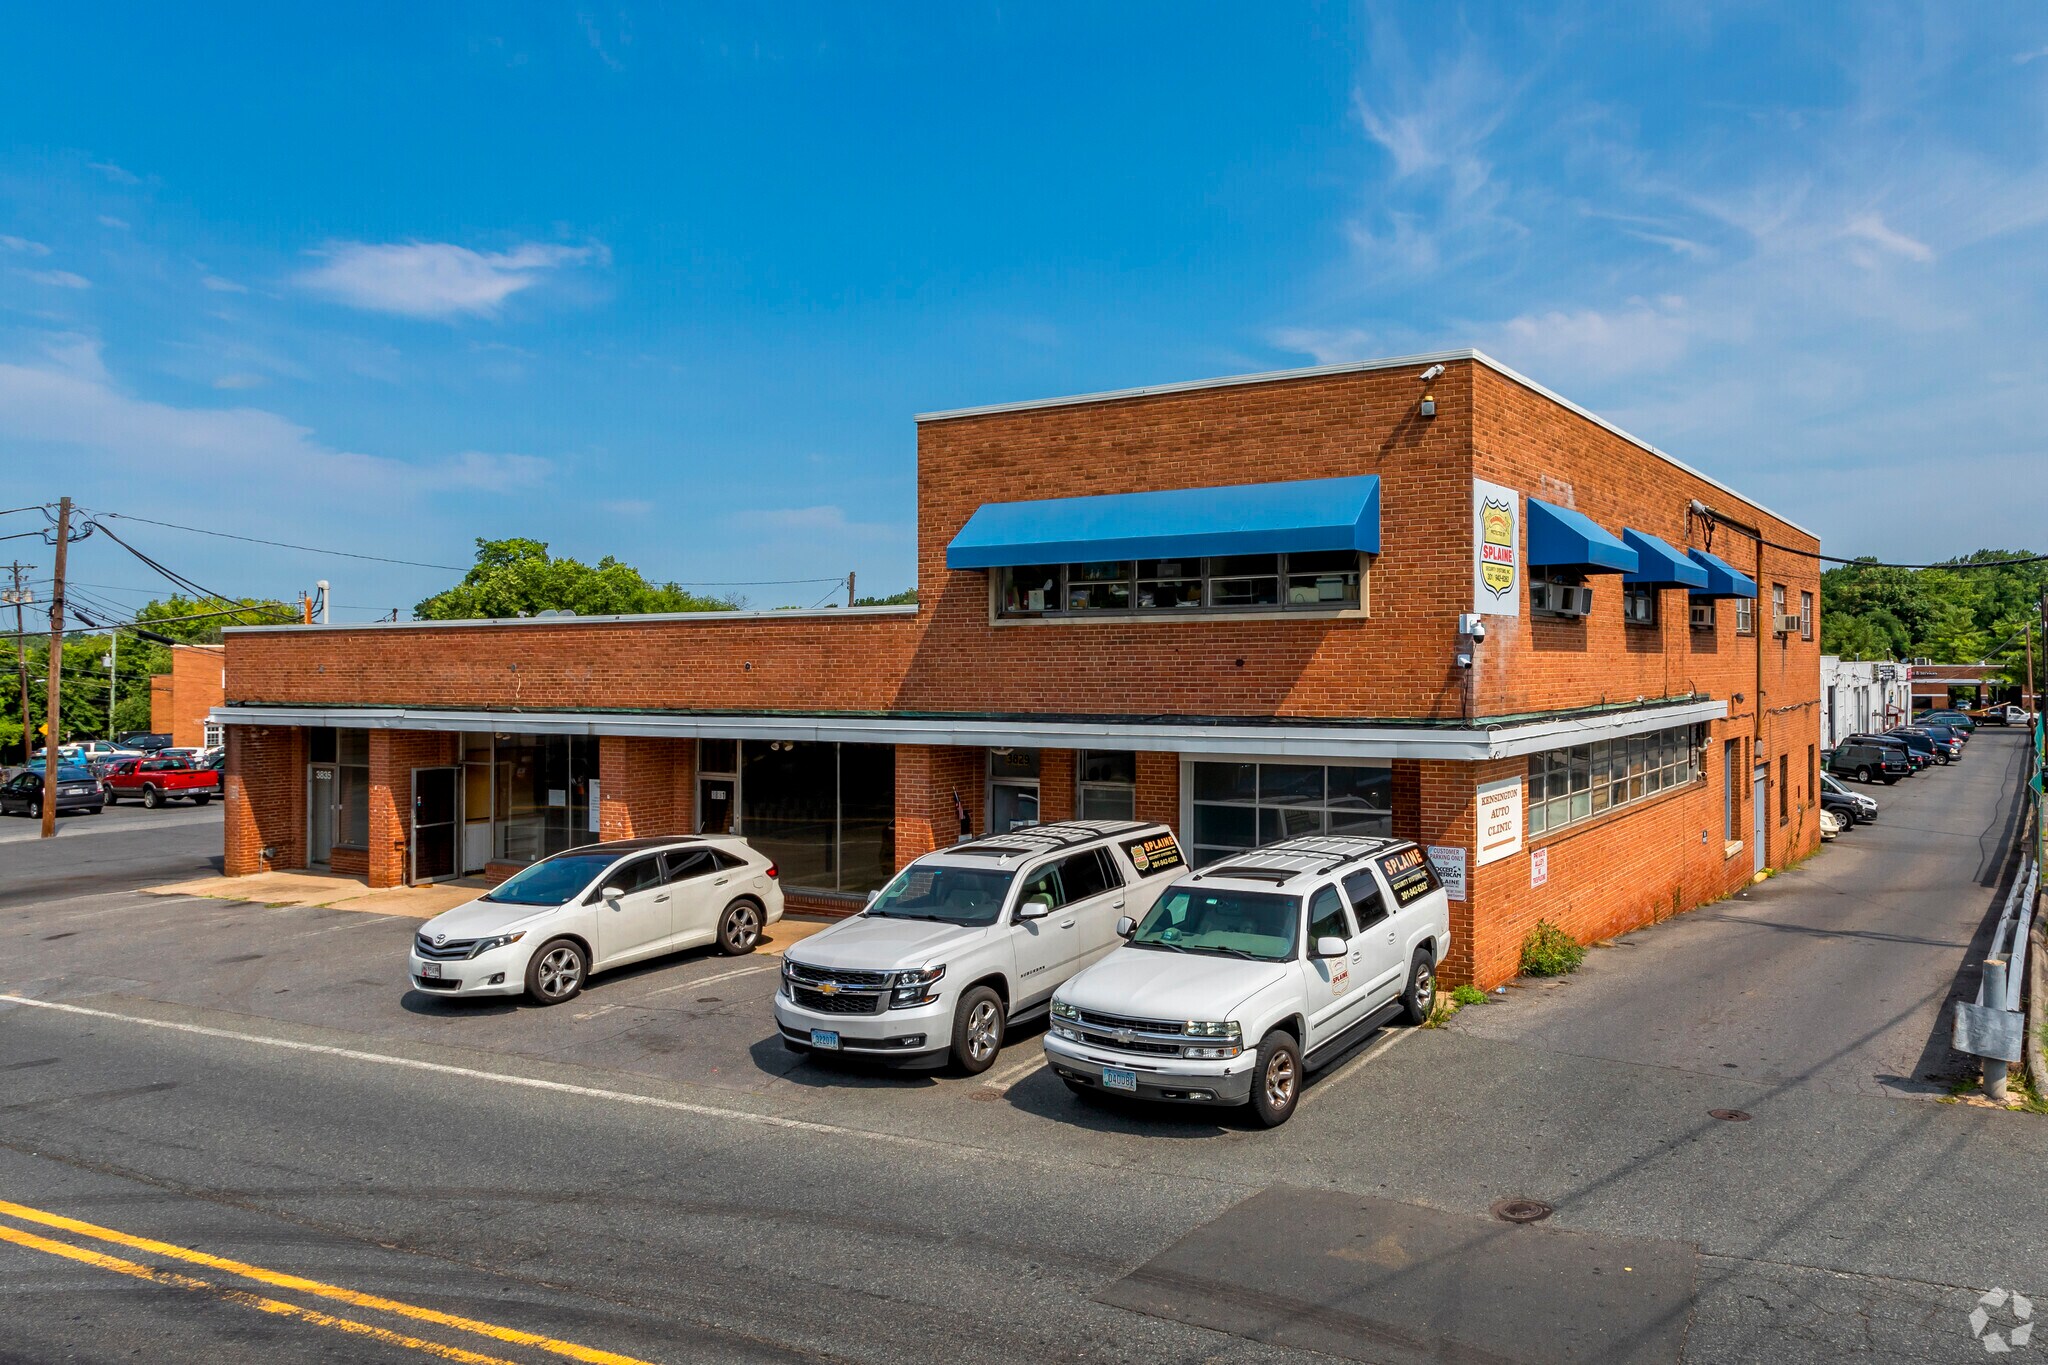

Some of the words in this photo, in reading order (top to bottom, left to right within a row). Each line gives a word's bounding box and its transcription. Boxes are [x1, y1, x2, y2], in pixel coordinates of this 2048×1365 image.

[1483, 544, 1512, 563] SPLAINE
[1007, 754, 1030, 764] 3829
[316, 770, 331, 780] 3835
[1481, 789, 1518, 806] KENSINGTON
[1491, 805, 1510, 819] AUTO
[1487, 821, 1512, 836] CLINIC
[1144, 836, 1174, 852] SPLAINE
[1430, 853, 1450, 861] PARKING
[1433, 848, 1460, 856] CUSTOMER
[1384, 848, 1423, 876] SPLAINE
[1393, 878, 1409, 891] SECURITY
[1020, 965, 1045, 978] SUBURBAN
[1332, 970, 1348, 983] SPLAINE
